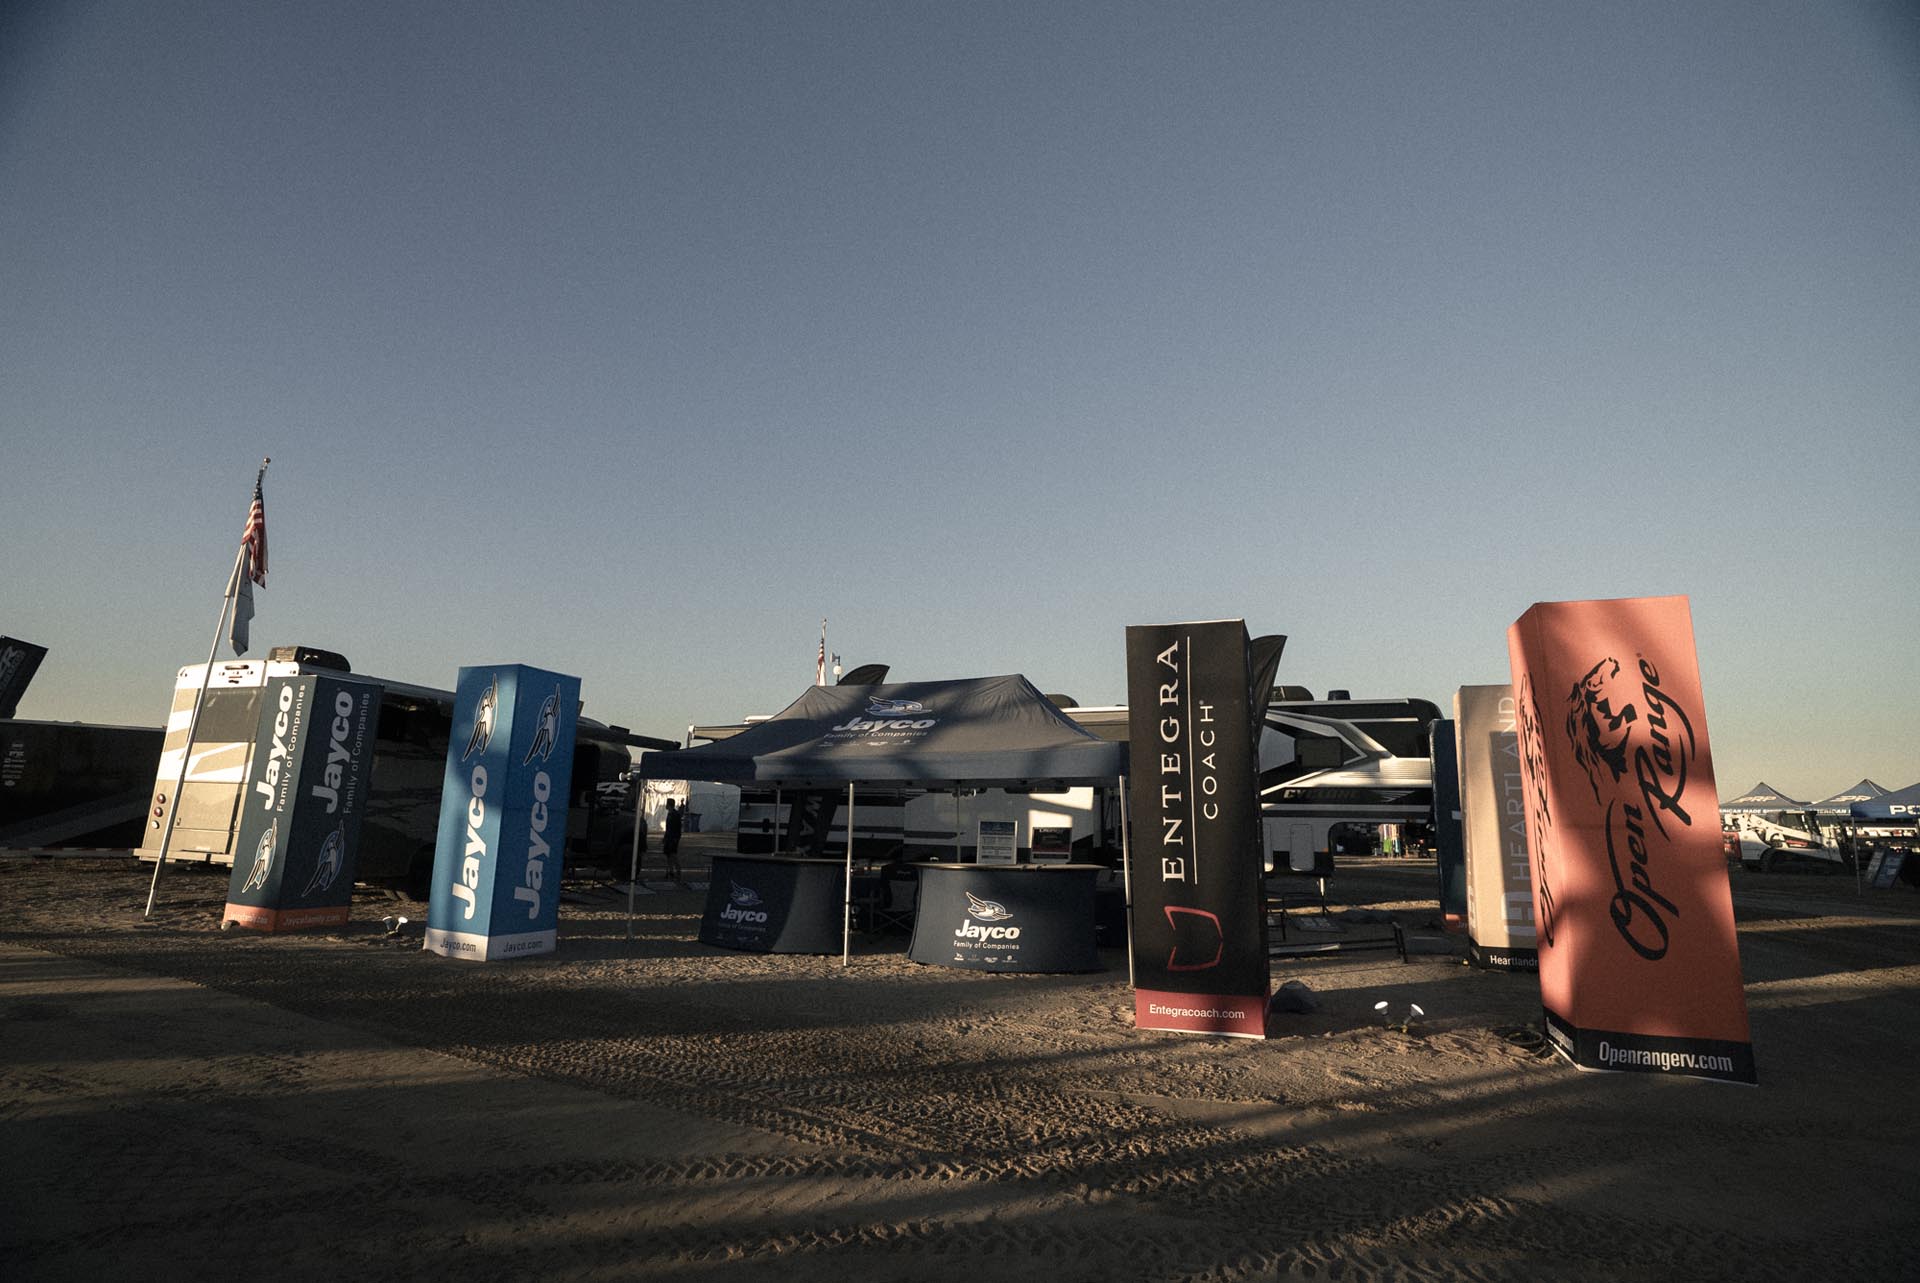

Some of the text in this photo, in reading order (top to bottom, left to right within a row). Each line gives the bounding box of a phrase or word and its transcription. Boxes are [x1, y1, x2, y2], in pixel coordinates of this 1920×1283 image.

[256, 685, 293, 811] Jayco
[276, 685, 305, 812] Family of Companies
[312, 691, 353, 814] Jayco
[343, 693, 370, 814] Family of Companies
[832, 717, 936, 732] Jayco
[1157, 640, 1186, 883] ENTEGRA
[1200, 705, 1218, 820] COACH
[452, 765, 487, 920] Jayco
[514, 771, 551, 920] Jayco
[1610, 658, 1695, 961] Open Range
[440, 937, 477, 953] Jayco.com
[504, 940, 543, 953] Jayco.com
[720, 903, 767, 923] Jayco
[953, 940, 973, 949] Family
[983, 942, 1020, 950] Companies
[955, 919, 1020, 941] Jayco
[1149, 1003, 1245, 1020] Entegracoach.com
[1599, 1041, 1735, 1073] Openrangerv.com
